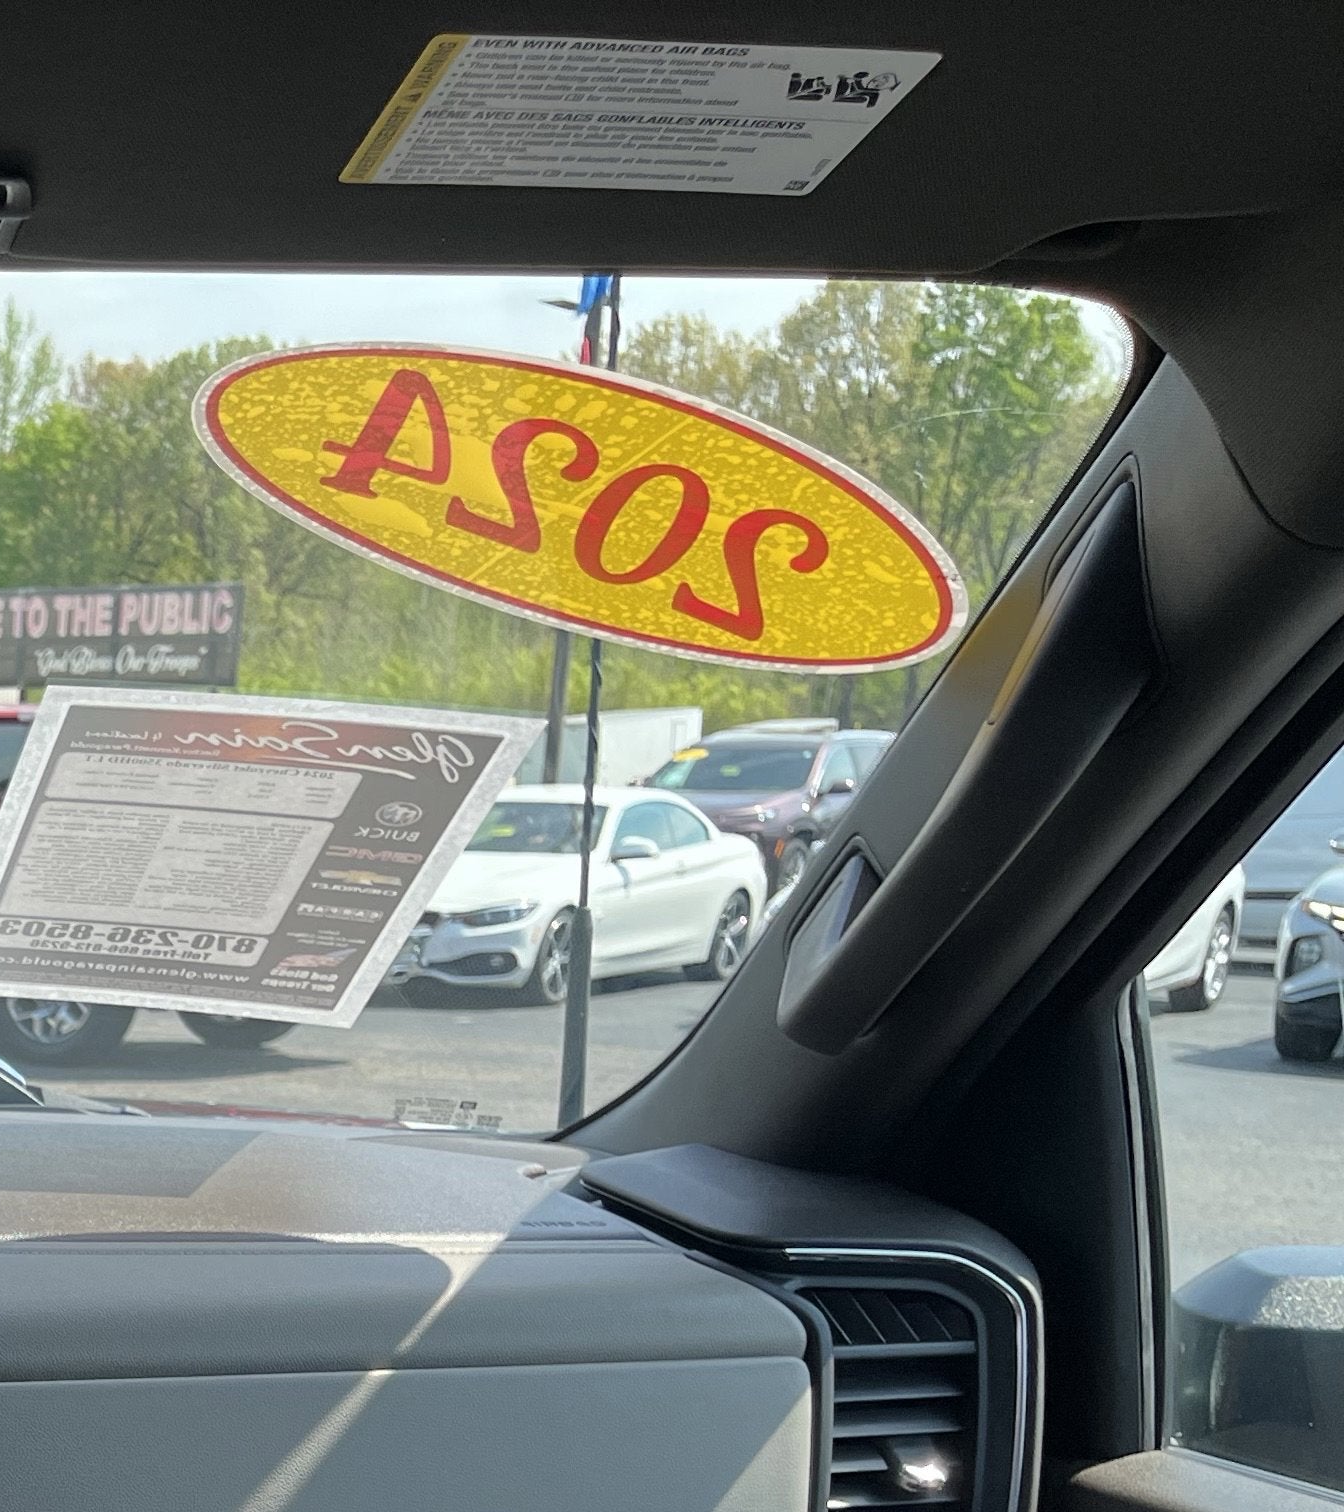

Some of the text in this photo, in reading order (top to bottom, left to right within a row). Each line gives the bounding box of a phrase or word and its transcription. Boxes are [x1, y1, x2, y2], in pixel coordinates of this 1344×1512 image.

[472, 40, 751, 57] EVEN WITH ADVANCED AIR BAGS
[472, 110, 515, 120] AVEC
[518, 110, 552, 121] DES
[552, 112, 593, 122] SACS
[699, 117, 806, 130] INTELLIGENTS
[10, 596, 50, 639] TO
[53, 594, 113, 638] THE
[117, 588, 234, 637] PUBLIC
